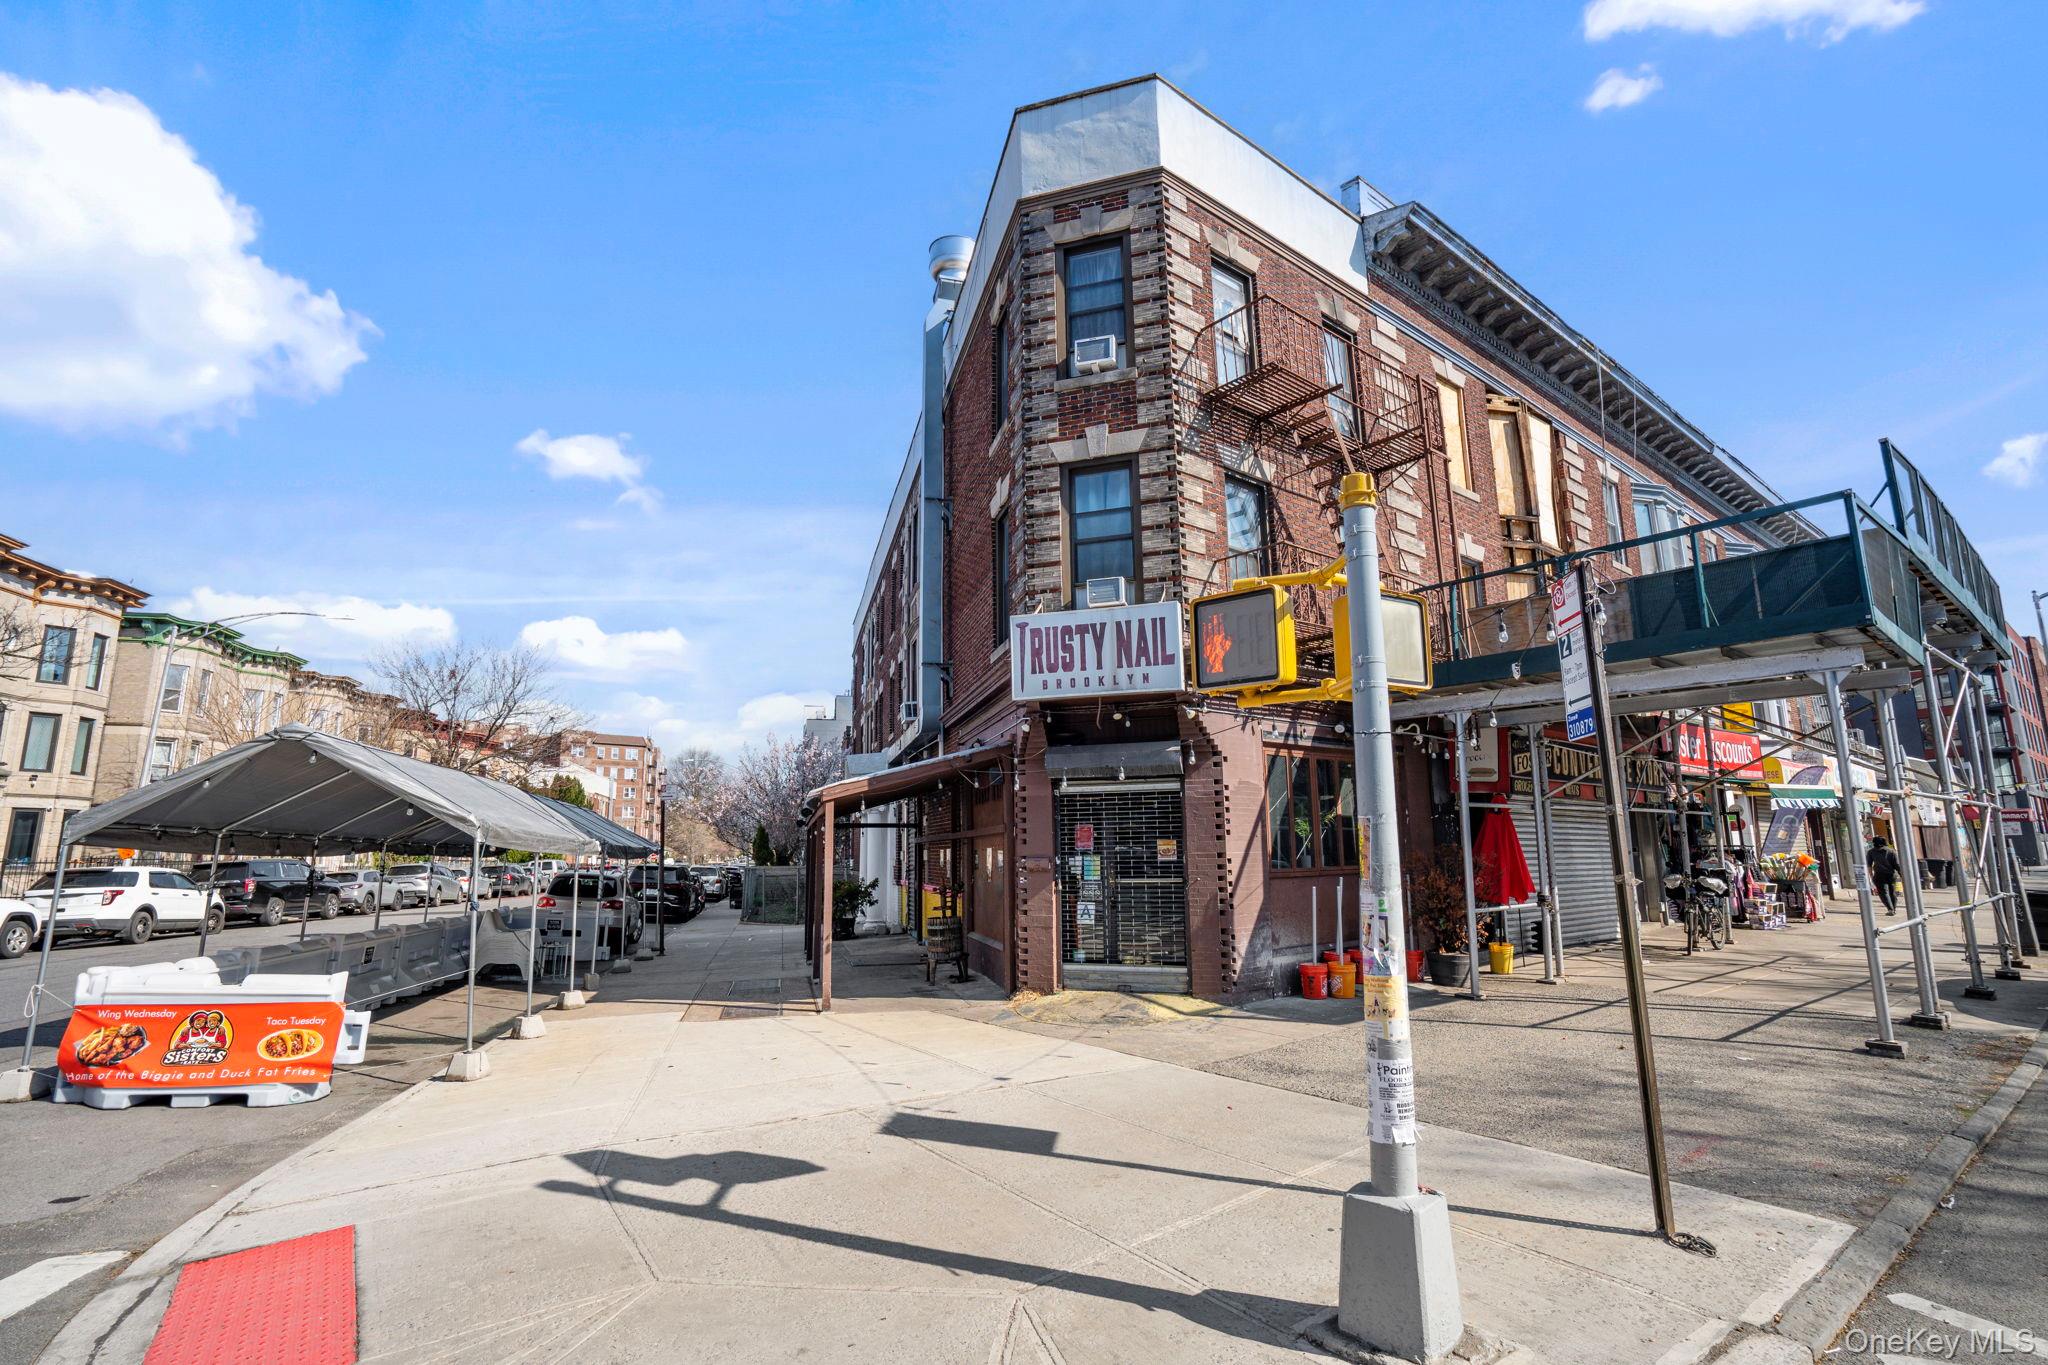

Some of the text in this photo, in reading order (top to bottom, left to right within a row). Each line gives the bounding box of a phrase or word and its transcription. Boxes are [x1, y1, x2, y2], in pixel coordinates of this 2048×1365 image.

[1115, 616, 1176, 668] NAIL
[1561, 635, 1570, 657] 2
[1042, 672, 1150, 690] BROOKLYN
[1569, 717, 1594, 738] 310879
[1552, 746, 1633, 783] CONVENE
[1080, 904, 1092, 919] A
[98, 1008, 177, 1019] Wing Wednesday
[266, 1016, 327, 1026] Taco Tuesday
[66, 1066, 317, 1082] Home of the Biggie and Duck Fat Fries
